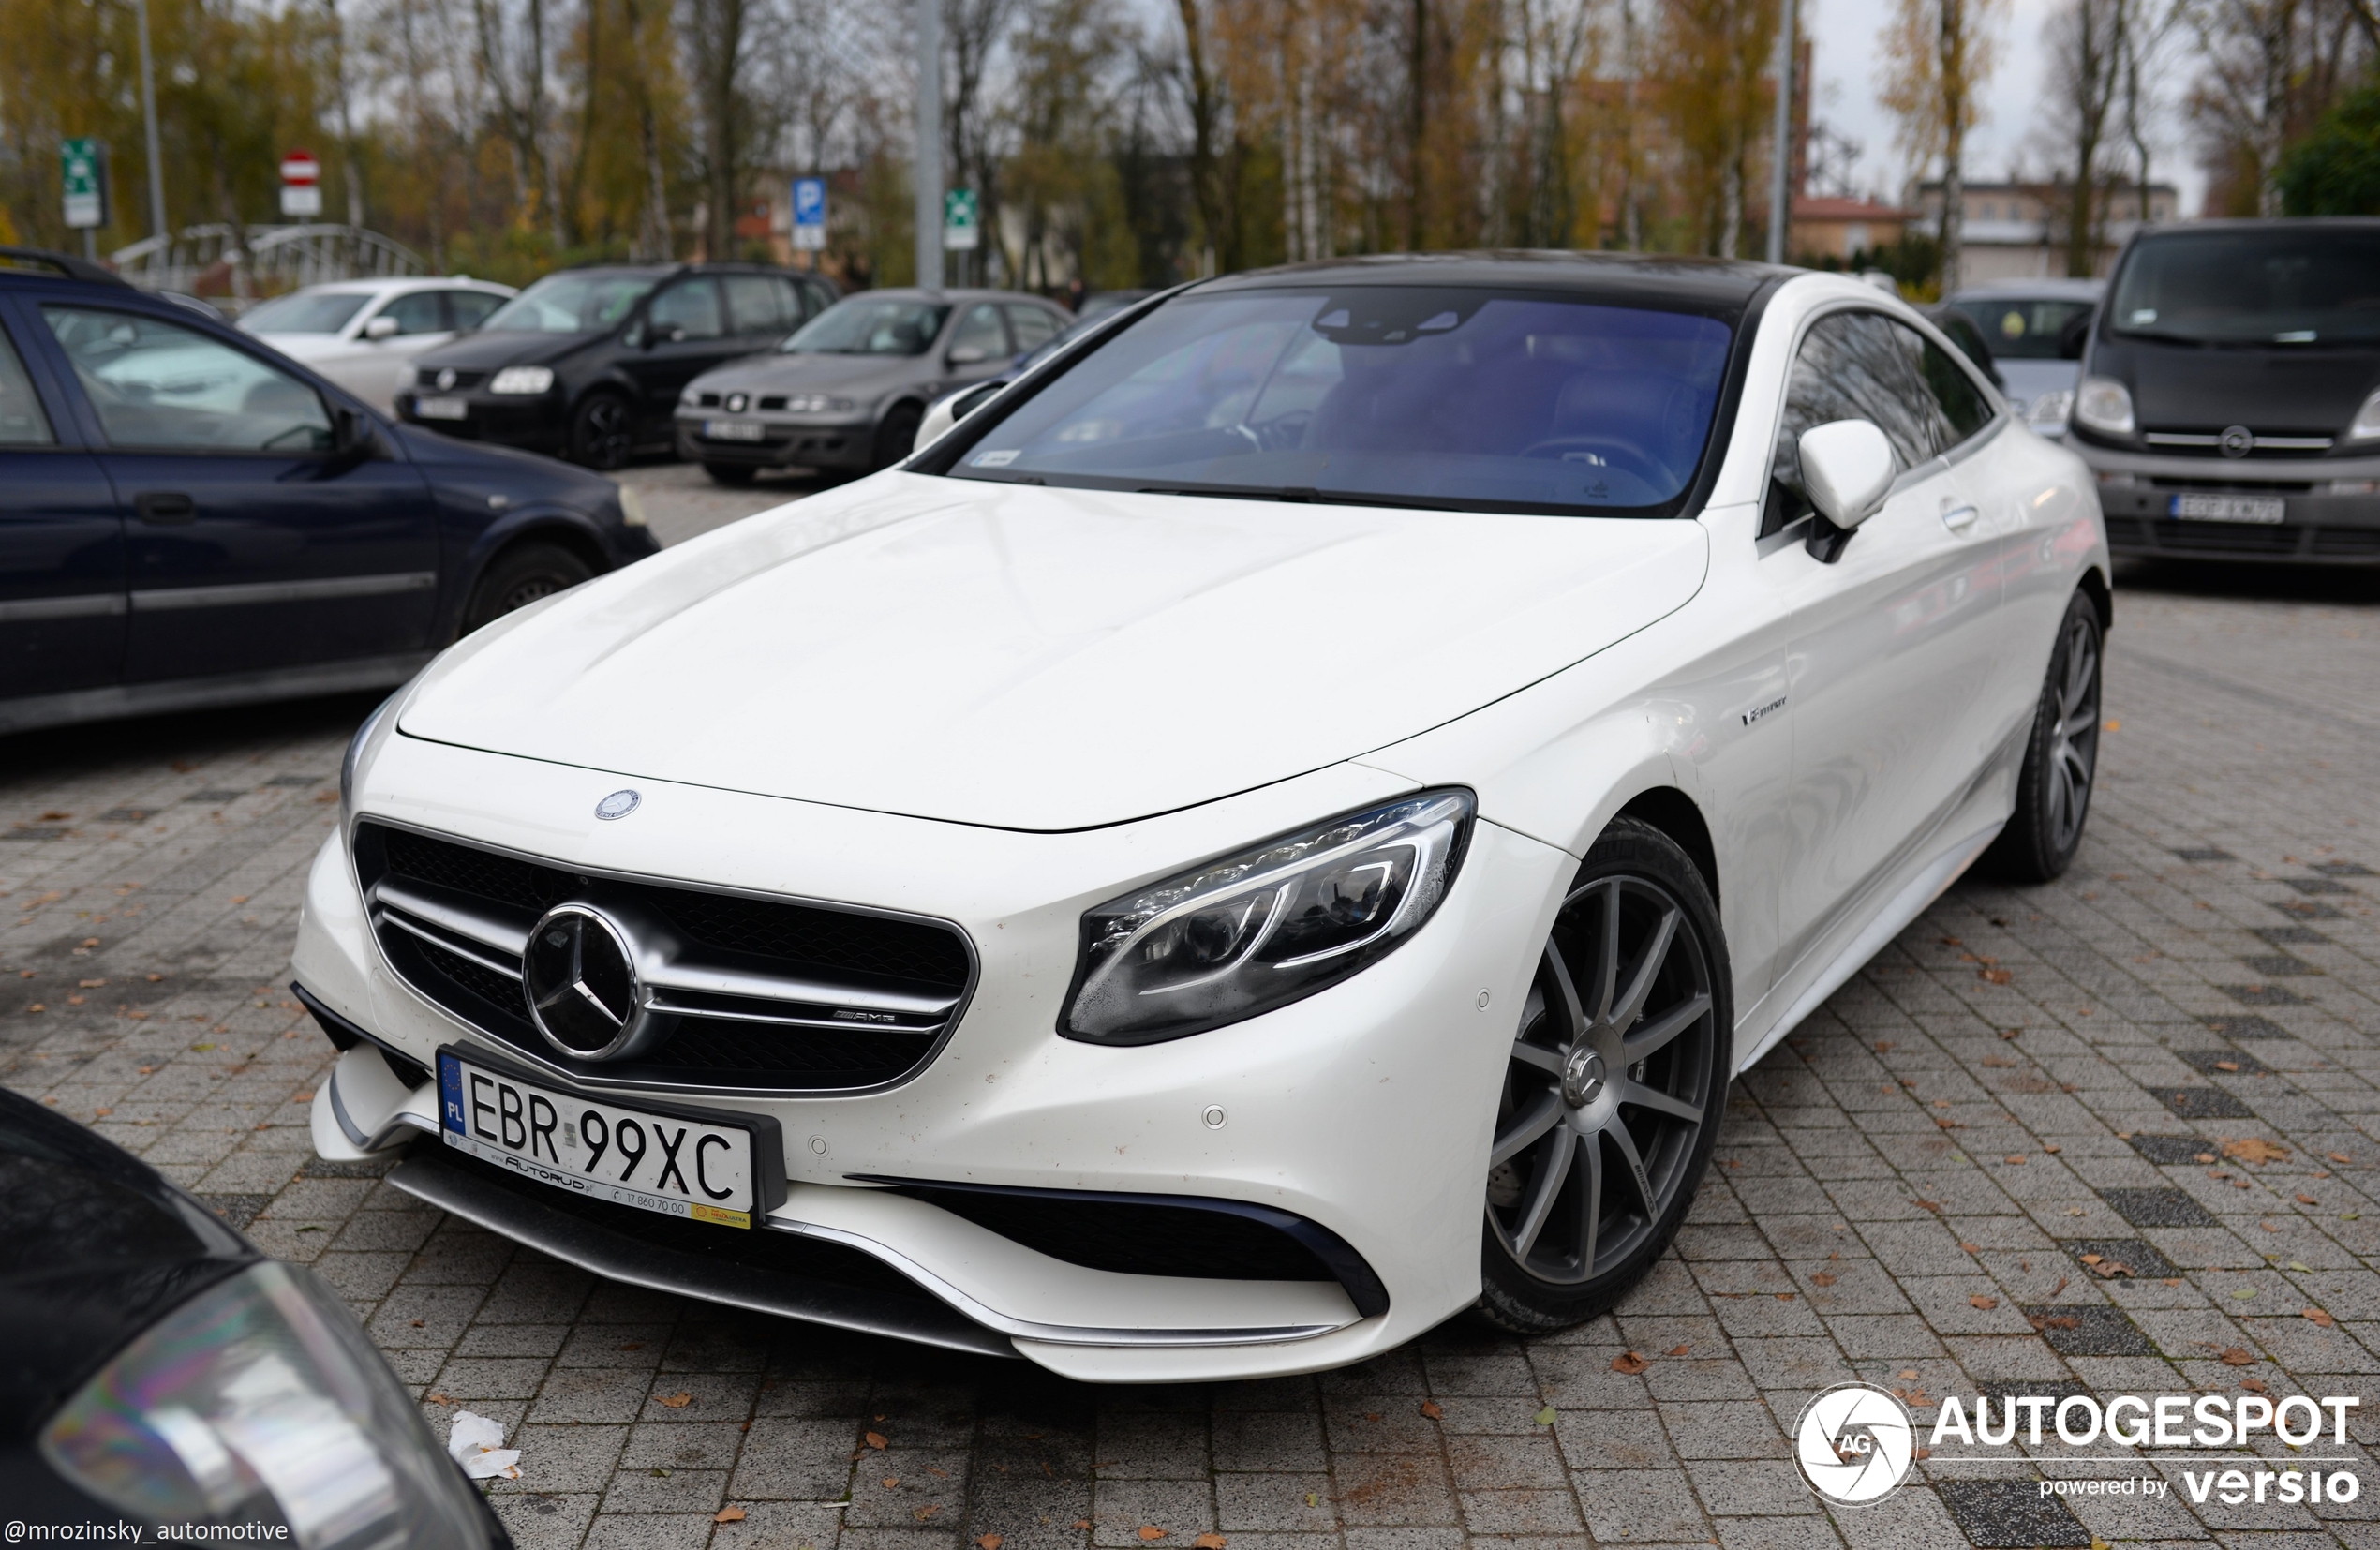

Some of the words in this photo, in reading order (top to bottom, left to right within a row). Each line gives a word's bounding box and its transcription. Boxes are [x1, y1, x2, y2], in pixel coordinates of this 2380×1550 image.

[448, 1101, 463, 1123] PL
[469, 1071, 559, 1165] EBR
[579, 1110, 734, 1200] 99XC
[626, 1193, 635, 1203] 17
[637, 1194, 655, 1208] 860
[657, 1200, 669, 1211] 70
[671, 1202, 685, 1214] 00
